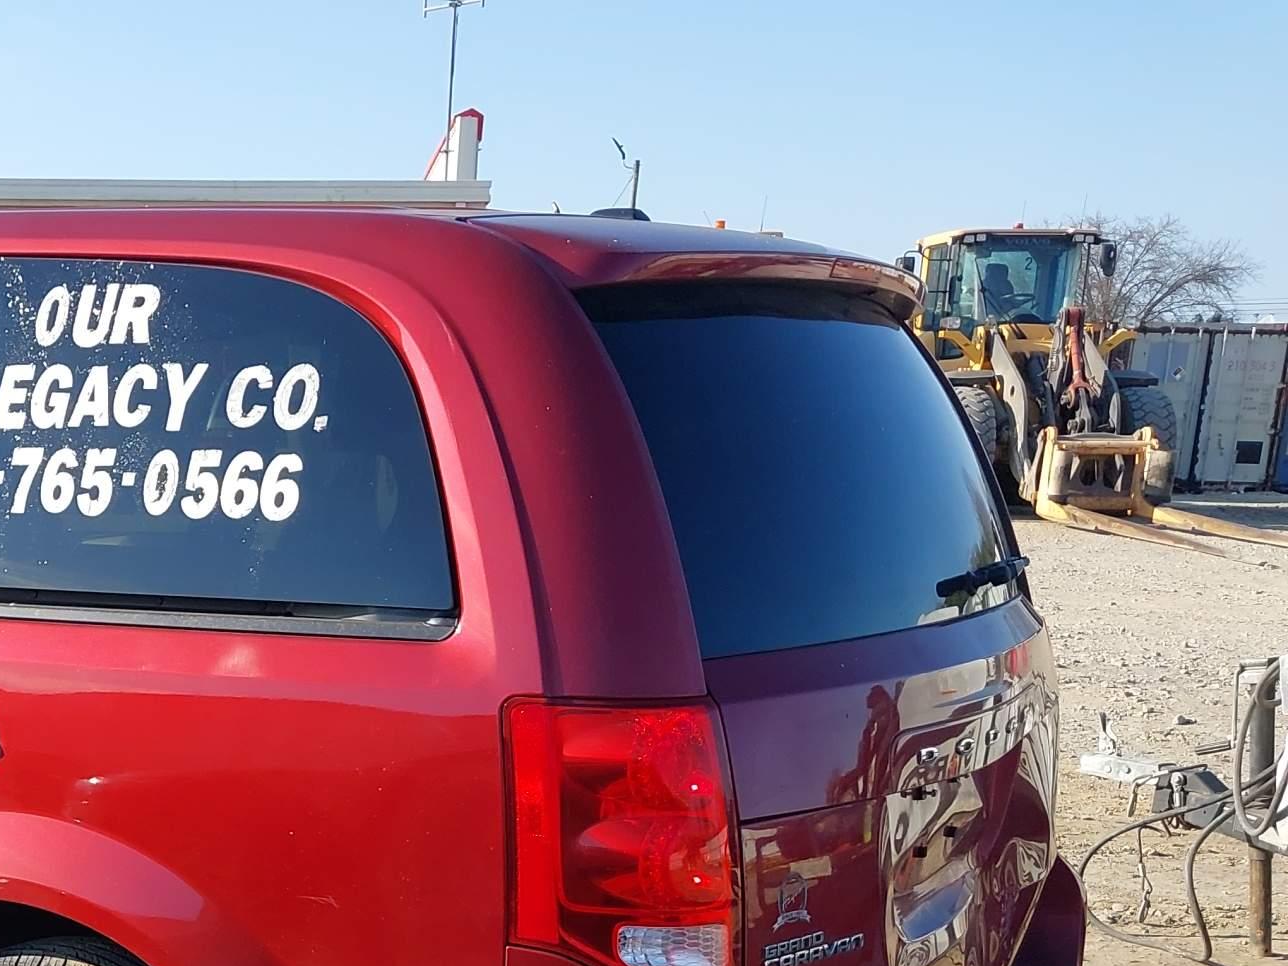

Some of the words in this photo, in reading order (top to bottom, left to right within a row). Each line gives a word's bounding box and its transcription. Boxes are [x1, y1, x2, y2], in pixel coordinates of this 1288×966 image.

[1025, 257, 1033, 270] 2
[34, 283, 161, 347] OUR
[226, 363, 328, 432] CO.
[764, 931, 825, 958] GRAND
